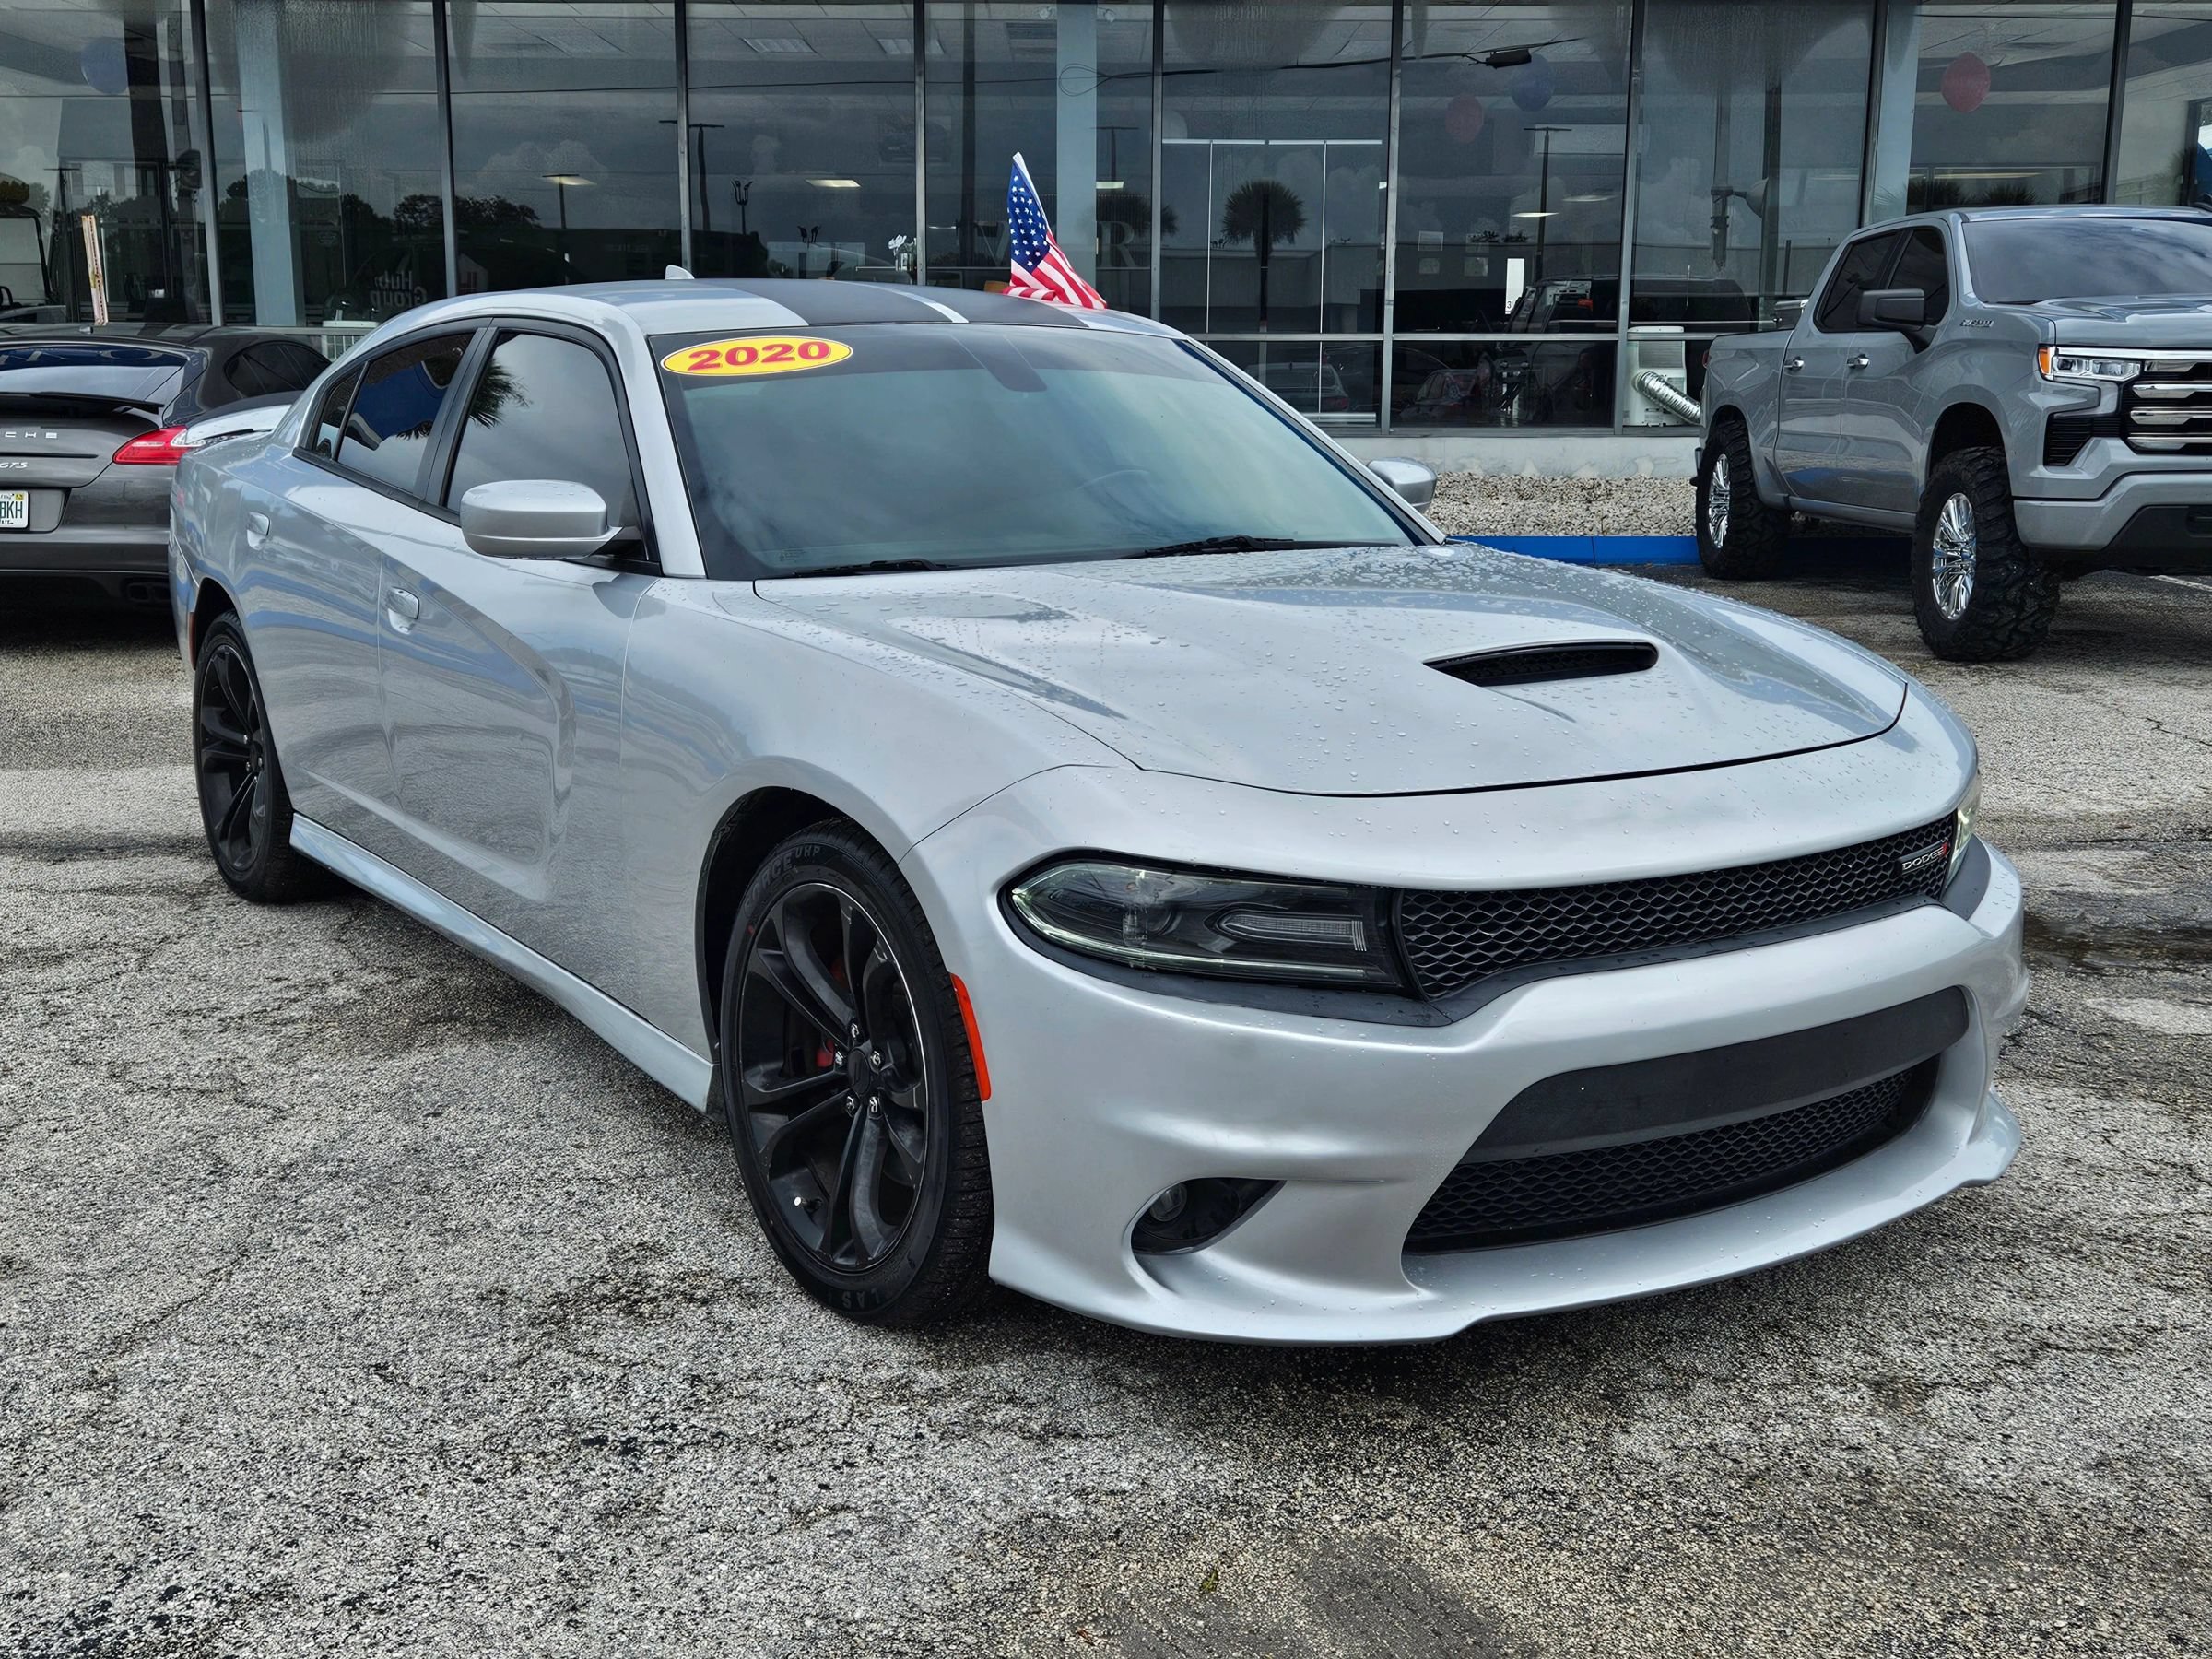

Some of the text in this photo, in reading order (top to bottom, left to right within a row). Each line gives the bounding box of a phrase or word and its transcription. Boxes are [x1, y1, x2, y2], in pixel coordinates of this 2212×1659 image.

[688, 341, 831, 371] 2020
[795, 845, 821, 858] UHP
[1901, 846, 1945, 870] DODGE
